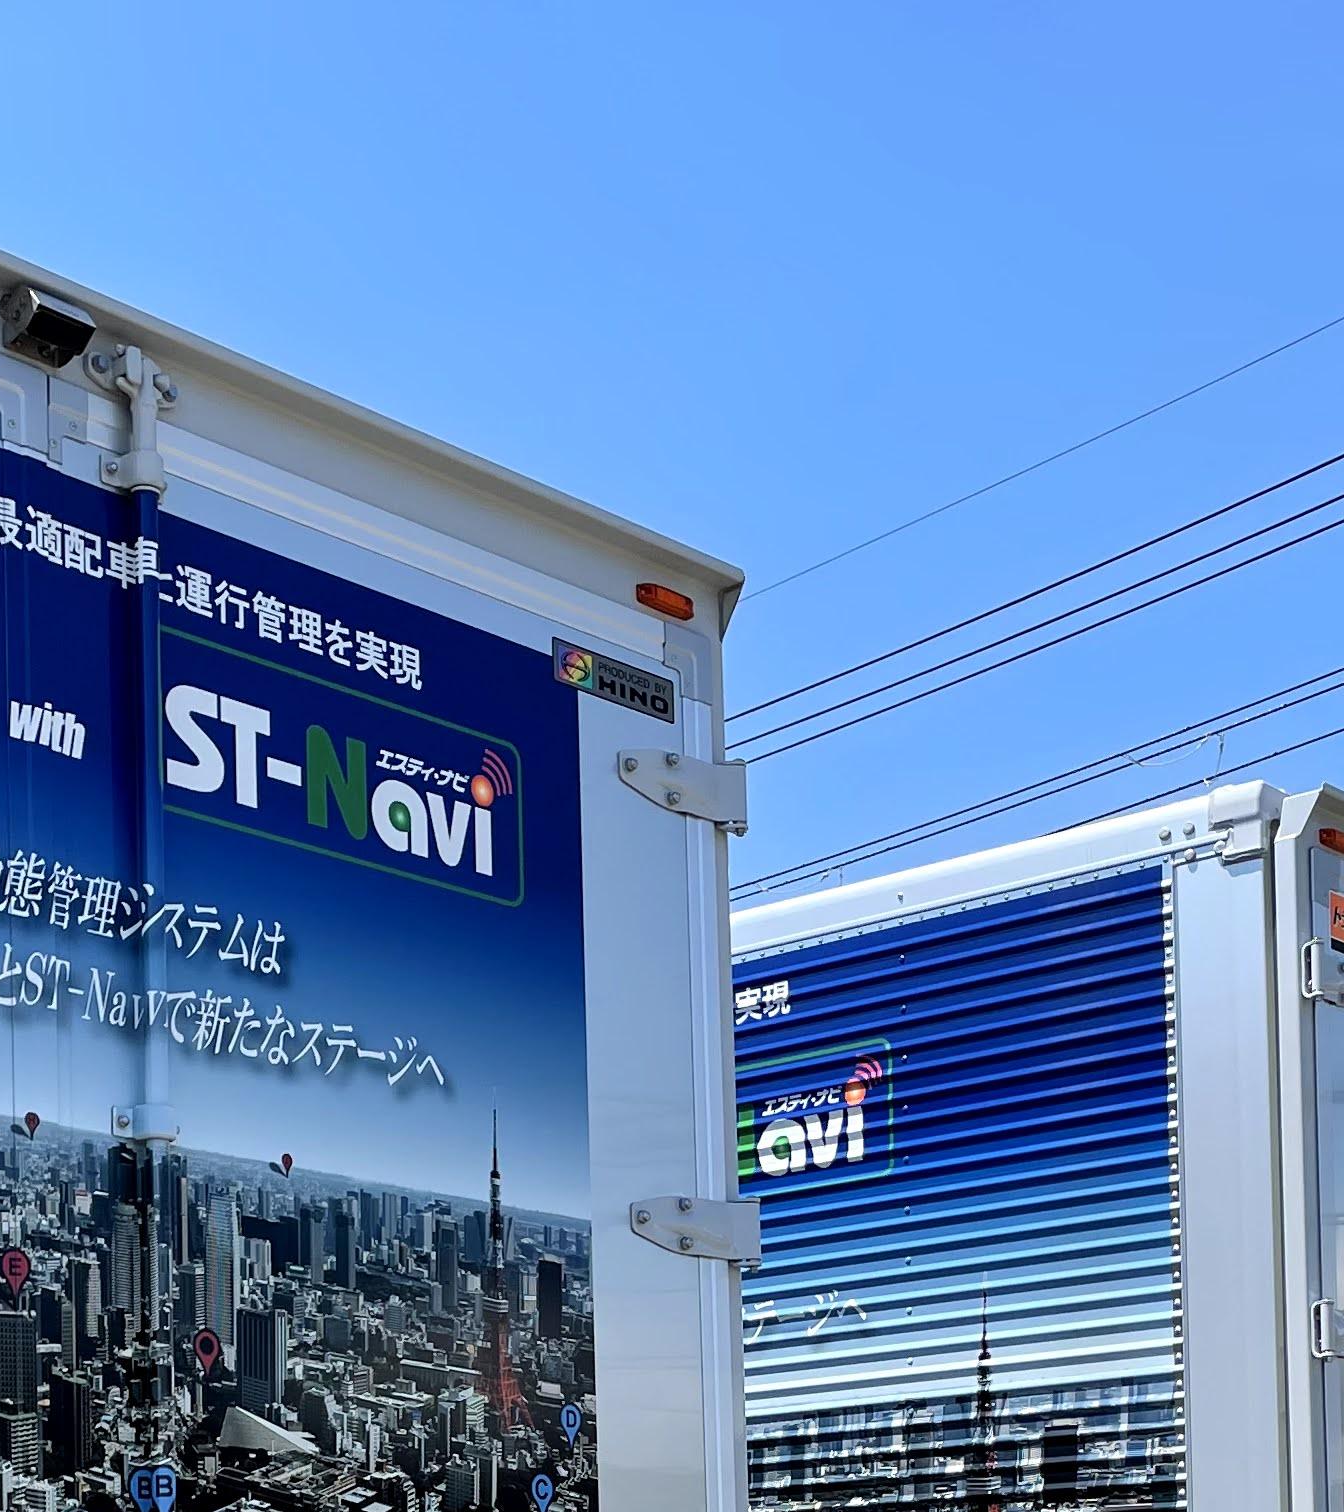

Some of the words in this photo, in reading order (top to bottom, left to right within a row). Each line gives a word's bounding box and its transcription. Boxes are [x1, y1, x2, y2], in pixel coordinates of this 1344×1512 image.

[598, 661, 650, 689] PRODUCED
[654, 682, 668, 695] BY
[598, 675, 669, 714] HINO
[9, 700, 87, 758] with
[165, 684, 494, 877] ST-Navi
[376, 748, 470, 793] エスティ・ナビ
[9, 1257, 22, 1277] E
[567, 1409, 577, 1428] D
[534, 1478, 550, 1499] C
